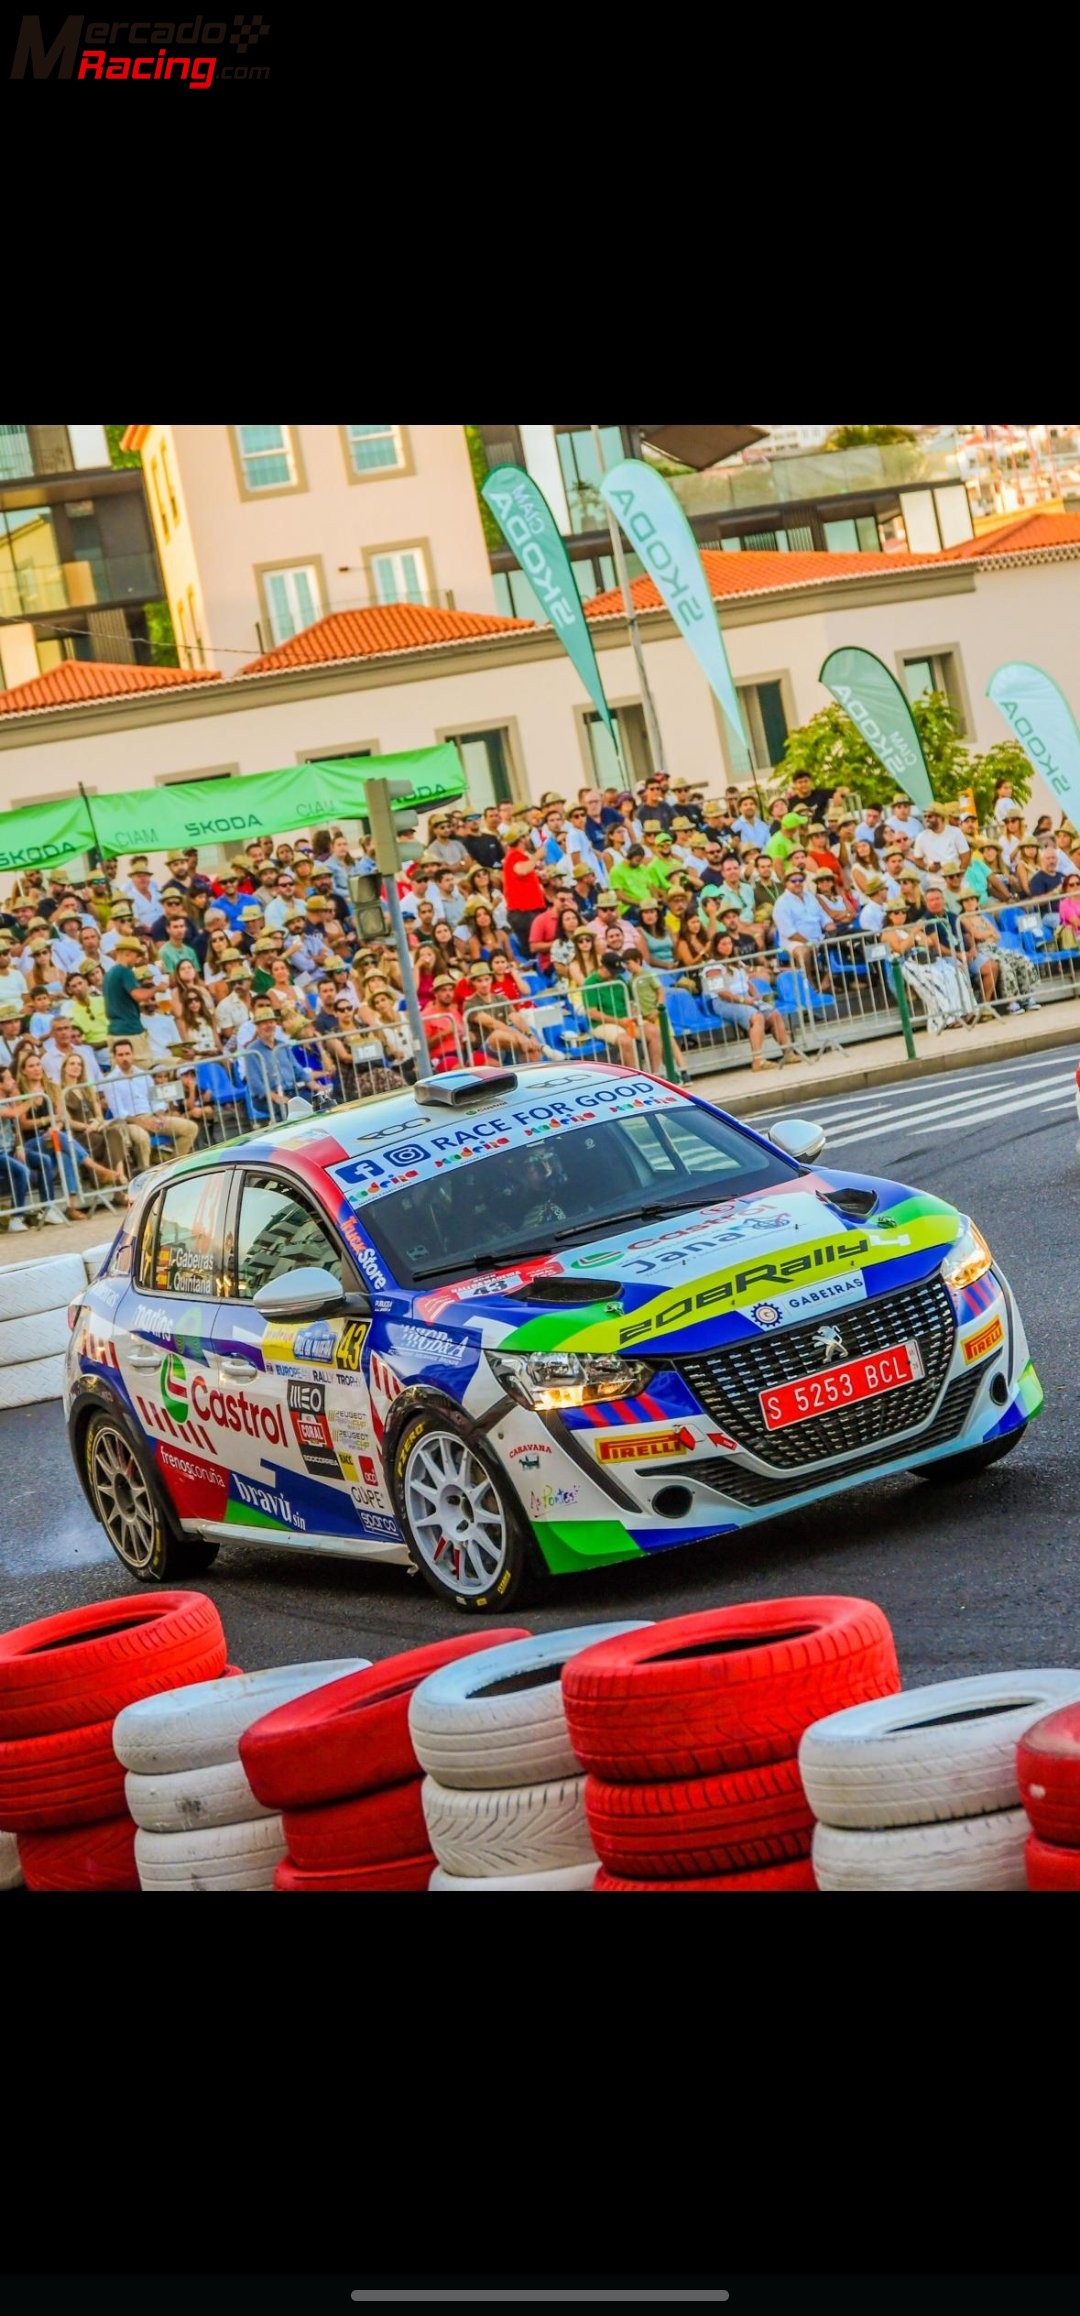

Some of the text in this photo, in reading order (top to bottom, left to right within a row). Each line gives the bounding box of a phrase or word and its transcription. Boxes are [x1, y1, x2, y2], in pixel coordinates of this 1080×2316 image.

[114, 828, 159, 848] CIAM
[430, 1082, 654, 1151] RACE FOR GOOD
[627, 1204, 778, 1251] Castrol
[473, 1280, 508, 1296] 43
[620, 1239, 869, 1345] 208Rally
[788, 1277, 864, 1309] GABEIRAS
[336, 1323, 368, 1371] 43
[190, 1375, 289, 1449] Castrol
[766, 1396, 782, 1421] S
[793, 1377, 853, 1412] 5253
[865, 1356, 908, 1389] BCL
[600, 1432, 683, 1461] PIRELLI
[232, 1473, 306, 1531] bravú sin
[360, 1512, 397, 1533] sparco
